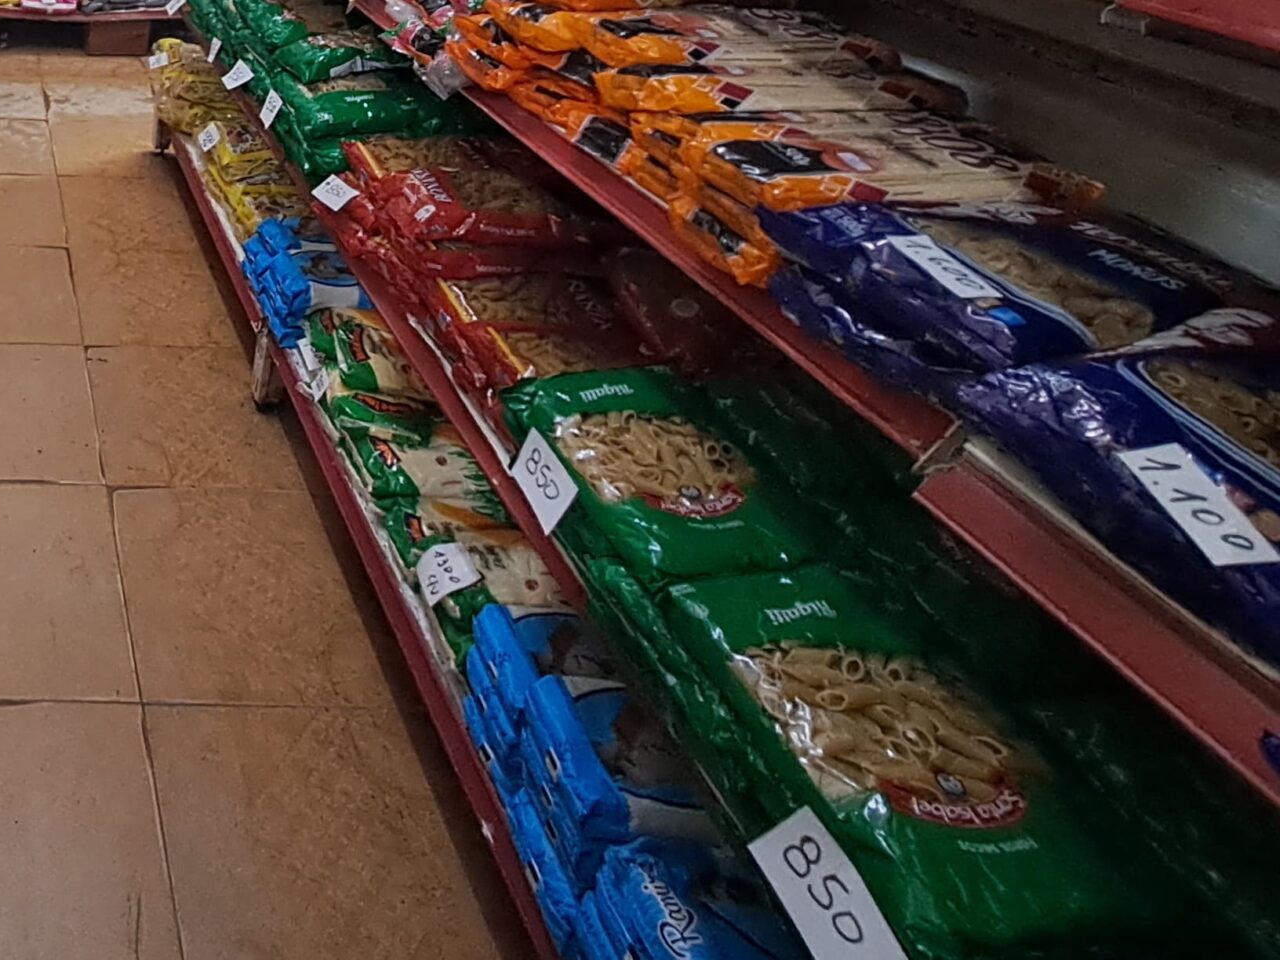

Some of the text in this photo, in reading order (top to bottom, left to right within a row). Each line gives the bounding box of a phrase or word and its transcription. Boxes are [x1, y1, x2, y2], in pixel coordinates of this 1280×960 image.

[524, 447, 560, 501] 850
[1140, 458, 1255, 552] 1.100
[782, 834, 864, 944] 850
